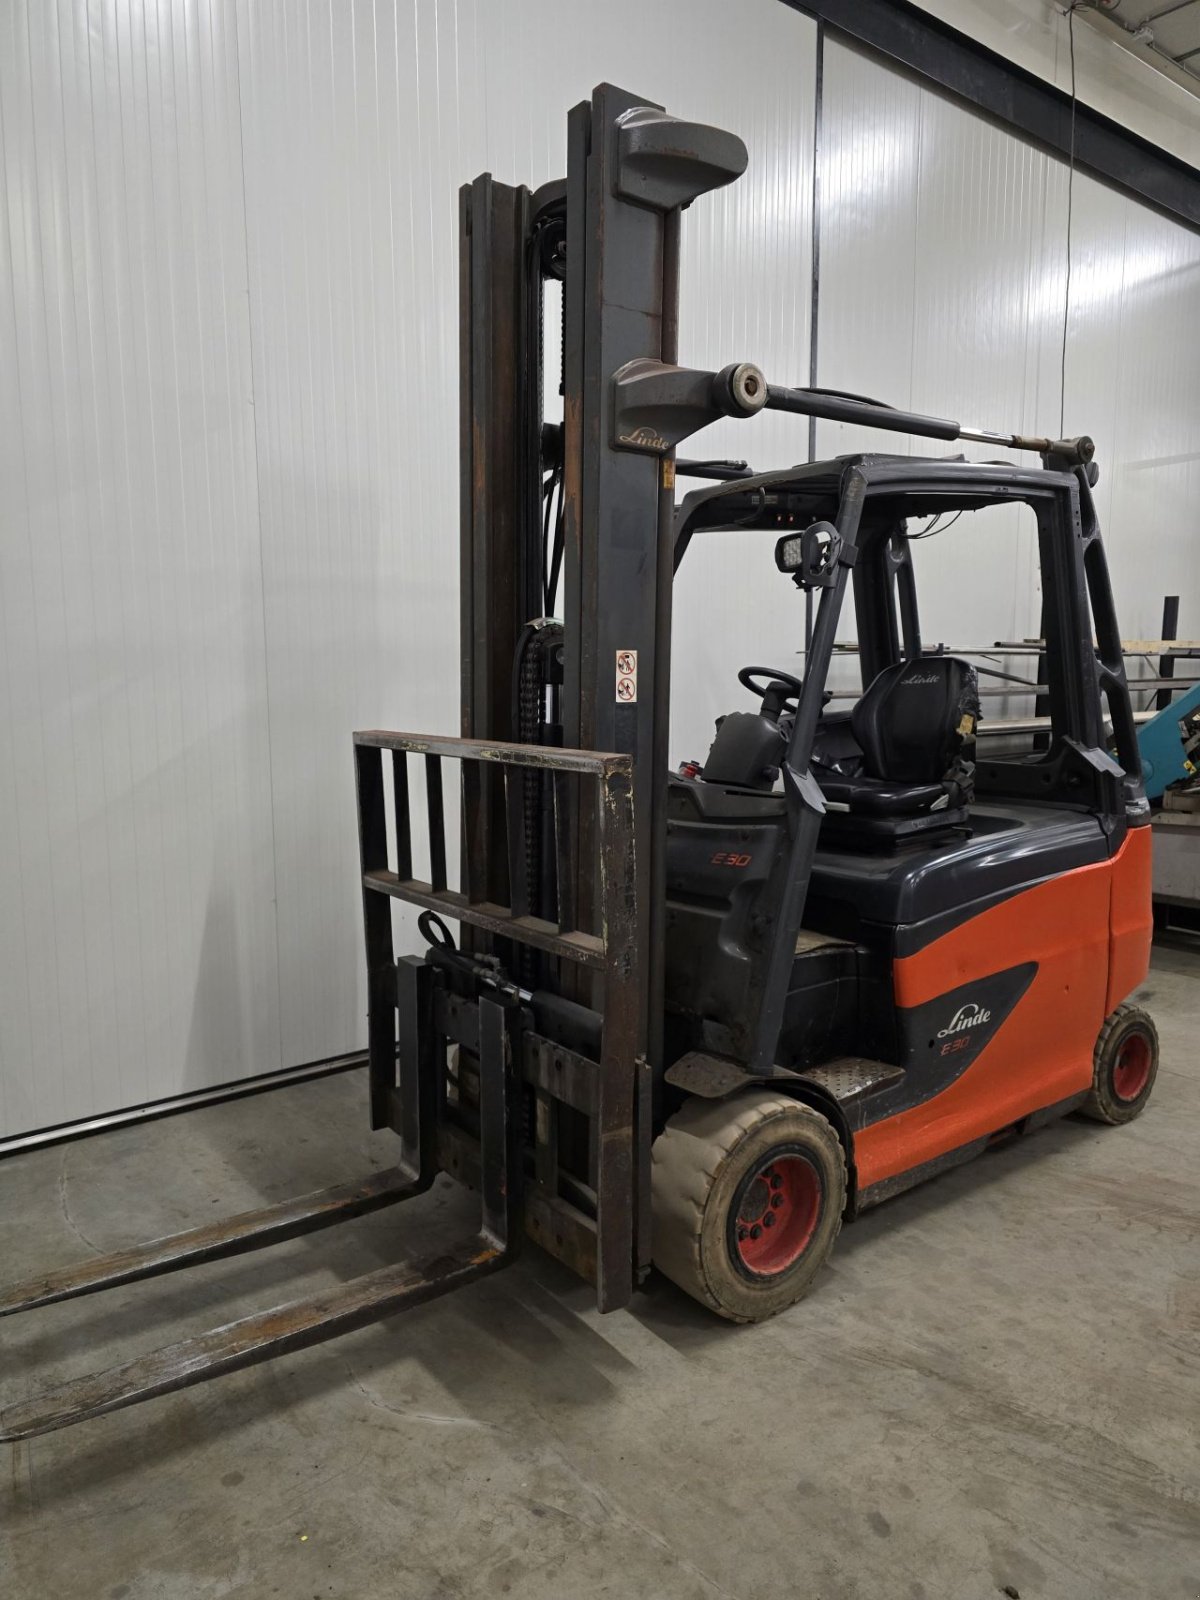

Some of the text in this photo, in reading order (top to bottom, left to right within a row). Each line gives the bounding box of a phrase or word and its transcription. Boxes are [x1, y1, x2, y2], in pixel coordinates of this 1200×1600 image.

[619, 426, 669, 450] Linde
[711, 852, 753, 867] E30
[936, 1003, 991, 1039] Linde
[940, 1035, 971, 1056] E30
